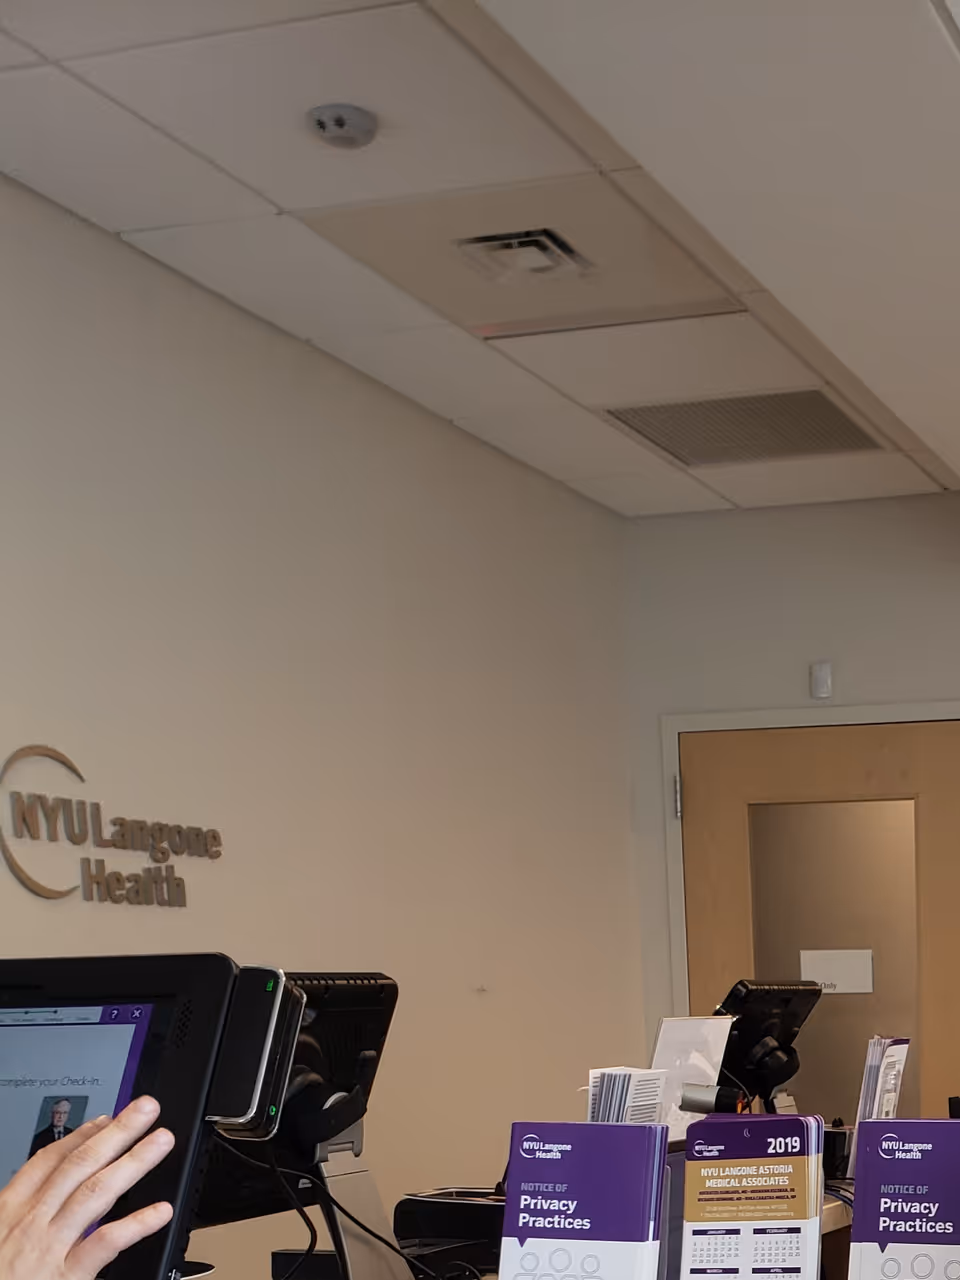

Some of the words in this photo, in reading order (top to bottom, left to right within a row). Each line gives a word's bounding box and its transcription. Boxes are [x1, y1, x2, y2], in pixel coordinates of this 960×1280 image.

[10, 791, 88, 845] NYU
[90, 802, 222, 863] Langone
[80, 857, 186, 907] Health
[523, 1141, 539, 1149] NYU
[540, 1142, 572, 1152] Langone
[767, 1137, 800, 1153] 2019
[882, 1141, 899, 1150] NYU
[899, 1141, 932, 1152] Langone
[535, 1151, 561, 1159] Health
[895, 1151, 922, 1159] Health
[701, 1167, 718, 1176] NYU
[720, 1166, 757, 1176] LANGONE
[759, 1165, 793, 1174] ASTORIA
[521, 1183, 554, 1192] NOTICE
[555, 1184, 568, 1192] OF
[705, 1178, 740, 1188] MEDICAL
[741, 1176, 789, 1187] ASSOCIATES
[880, 1184, 915, 1194] NOTICE
[916, 1185, 929, 1194] OF
[520, 1195, 577, 1214] Privacy
[880, 1198, 939, 1217] Privacy
[518, 1213, 591, 1229] Practices
[879, 1217, 953, 1233] Practices
